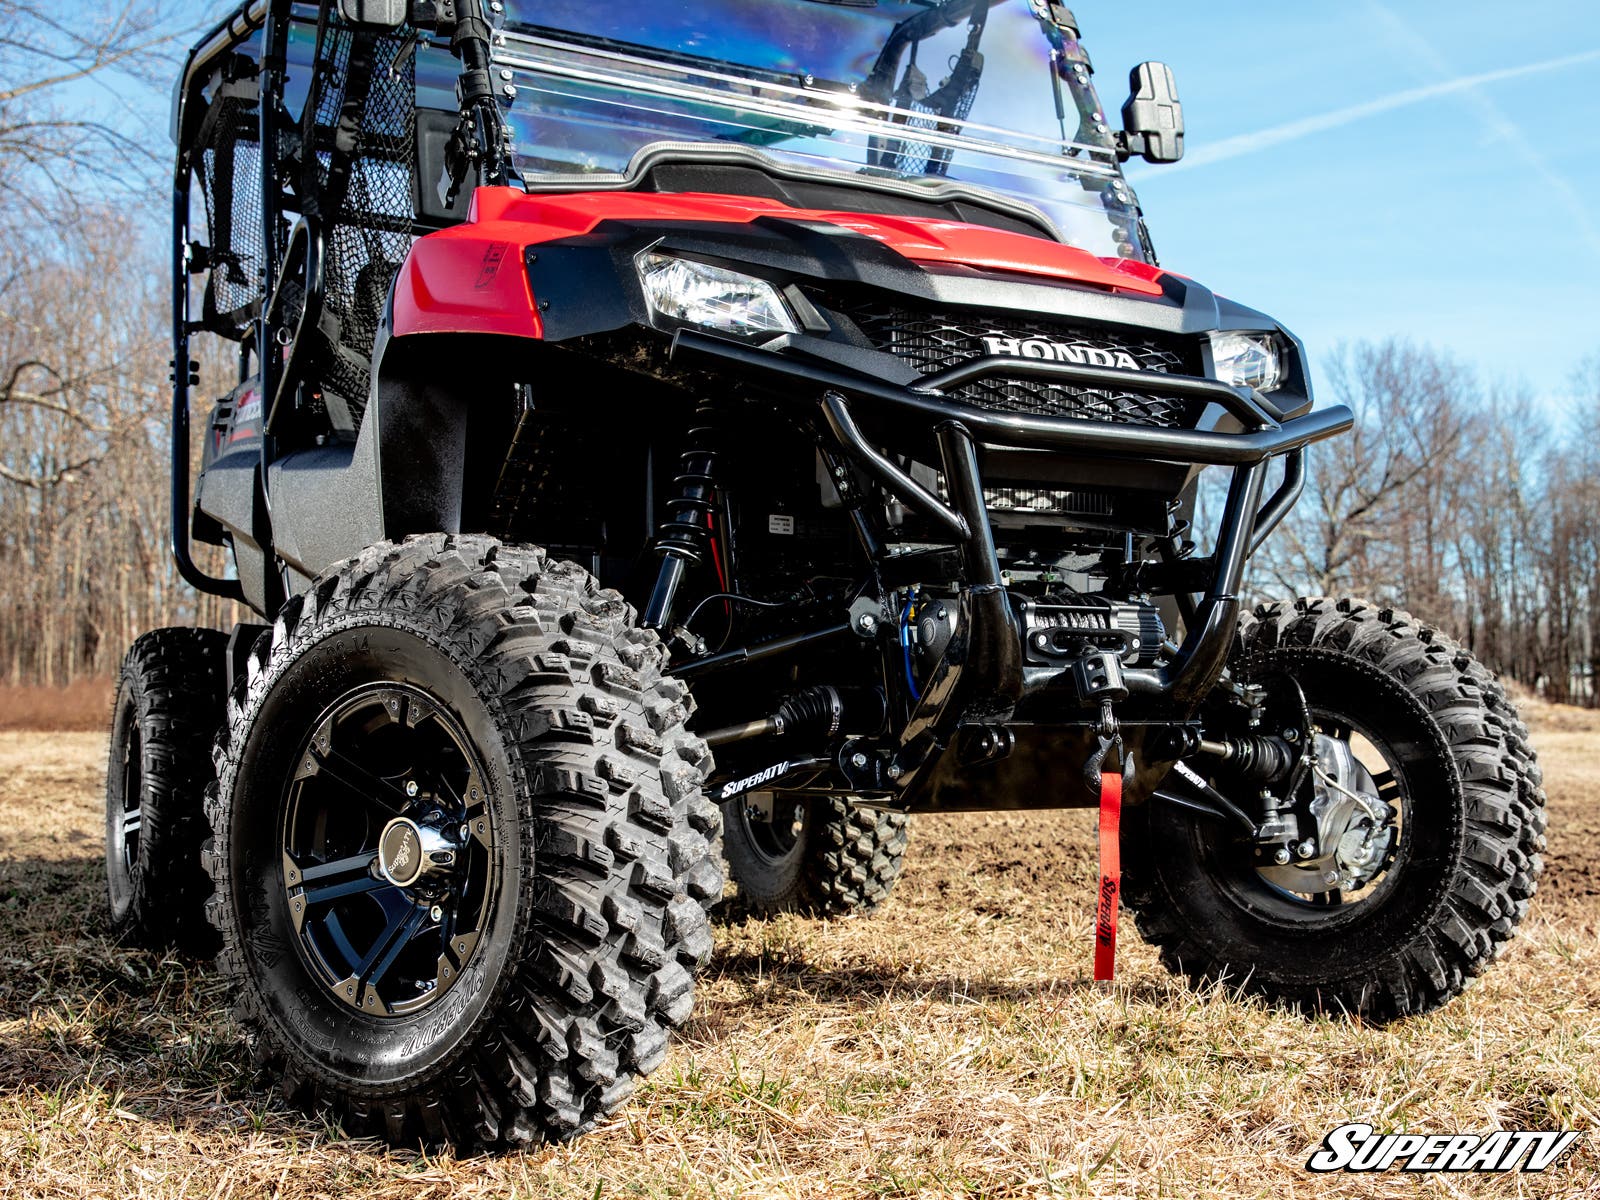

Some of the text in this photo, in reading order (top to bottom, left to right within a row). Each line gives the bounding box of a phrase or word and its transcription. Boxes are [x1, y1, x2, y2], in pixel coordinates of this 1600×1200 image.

[982, 337, 1140, 370] HONDA
[721, 761, 789, 798] SUPERATV
[1099, 875, 1116, 947] SUPERATV
